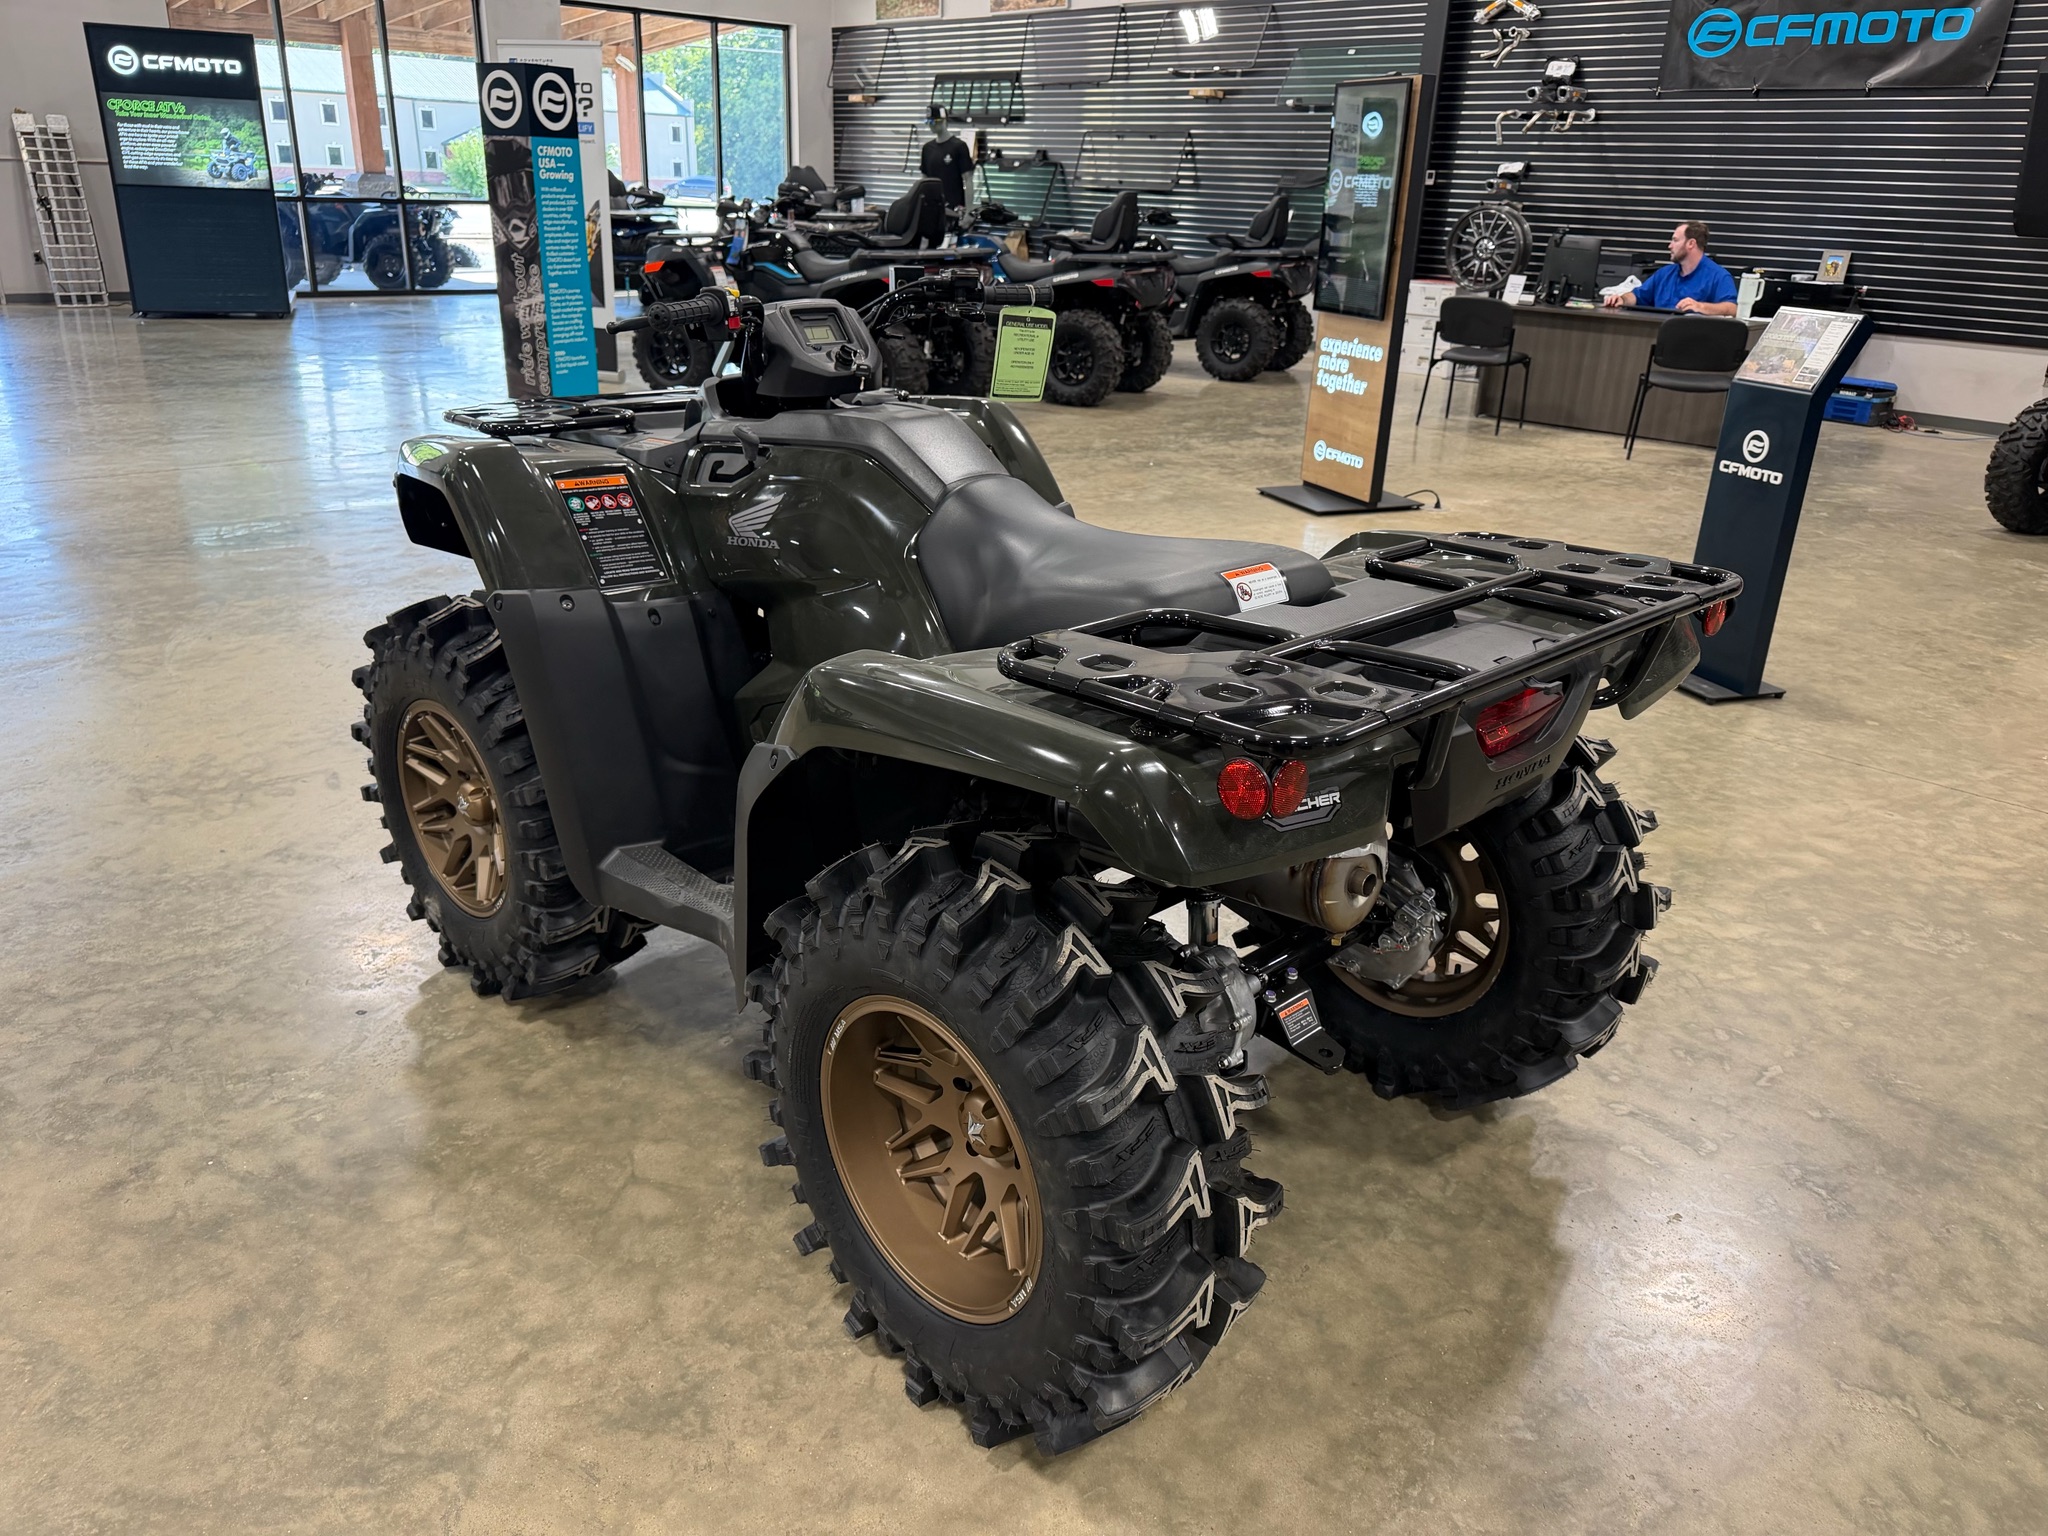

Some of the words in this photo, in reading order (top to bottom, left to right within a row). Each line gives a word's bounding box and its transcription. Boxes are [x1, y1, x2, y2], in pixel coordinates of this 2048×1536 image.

[1745, 7, 1975, 47] CFMOTO
[142, 54, 243, 75] CFMOTO
[107, 98, 156, 112] CFORCE
[537, 145, 573, 158] CFMOTO
[538, 158, 557, 169] USA
[539, 169, 575, 183] Growing
[1320, 337, 1383, 362] experience
[1318, 354, 1350, 373] more
[1316, 369, 1368, 395] together
[1325, 447, 1364, 469] CFMOTO
[1719, 460, 1783, 486] CFMOTO
[727, 536, 780, 549] HONDA
[1494, 753, 1552, 791] HONDA
